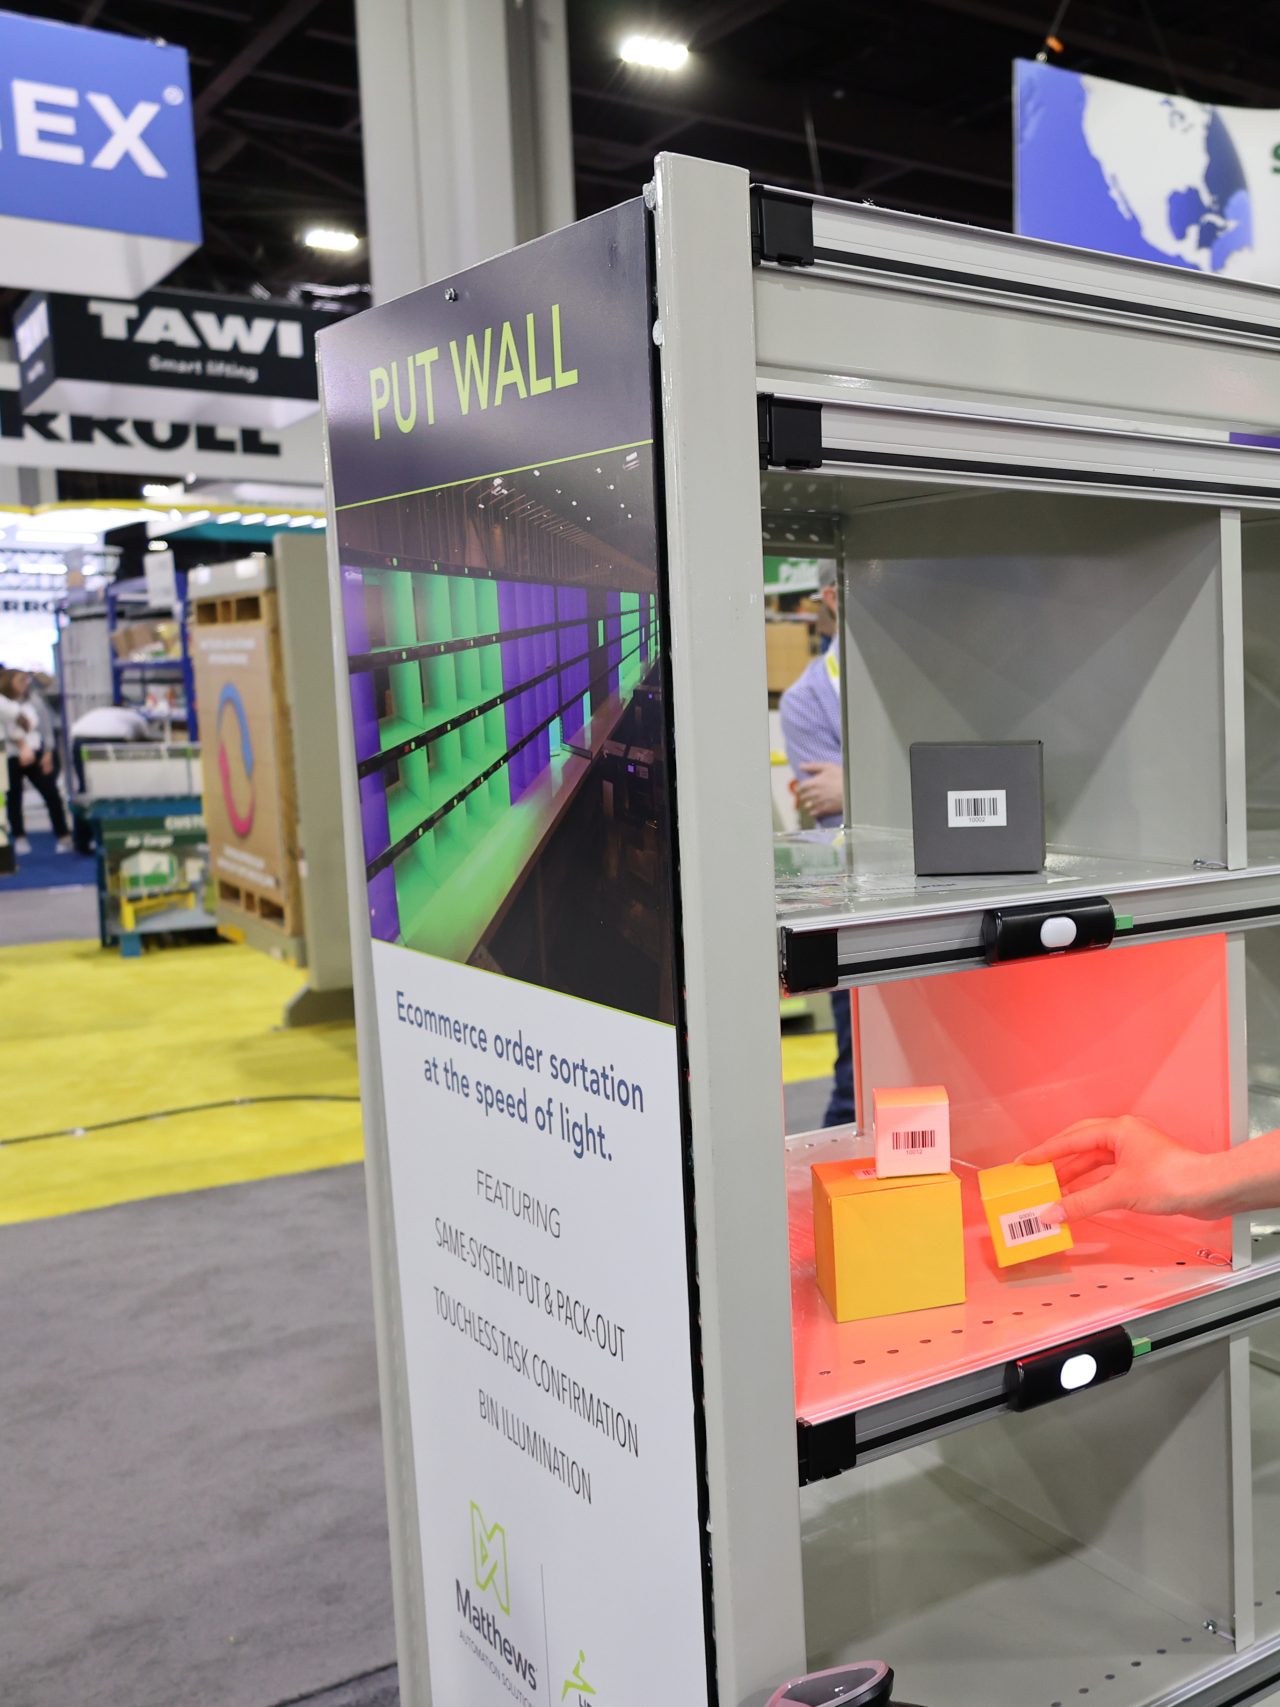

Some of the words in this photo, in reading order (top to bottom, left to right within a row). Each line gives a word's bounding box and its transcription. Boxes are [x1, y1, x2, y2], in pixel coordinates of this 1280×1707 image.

[87, 300, 303, 359] TAWI
[148, 354, 203, 376] Smart
[205, 357, 259, 383] lifting
[369, 347, 439, 440] PUT
[449, 304, 578, 416] WALL
[396, 990, 488, 1052] Ecommerce
[494, 1030, 543, 1073] order
[550, 1054, 645, 1113] sortation
[424, 1057, 440, 1085] at
[444, 1058, 470, 1098] the
[476, 1081, 528, 1124] speed
[535, 1098, 554, 1135] of
[560, 1102, 613, 1161] light.
[476, 1169, 561, 1239] FEATURING
[435, 1217, 515, 1292] SAME-SYSTEM
[517, 1265, 541, 1308] PUT
[544, 1282, 554, 1317] &
[556, 1289, 625, 1362] PACK-OUT
[433, 1286, 499, 1357] TOUCHLESS
[499, 1330, 530, 1380] TASK
[532, 1354, 639, 1458] CONFIRMATION
[479, 1388, 500, 1431] BIN
[501, 1405, 592, 1505] ILLUMINATION
[455, 1578, 537, 1691] Matthews
